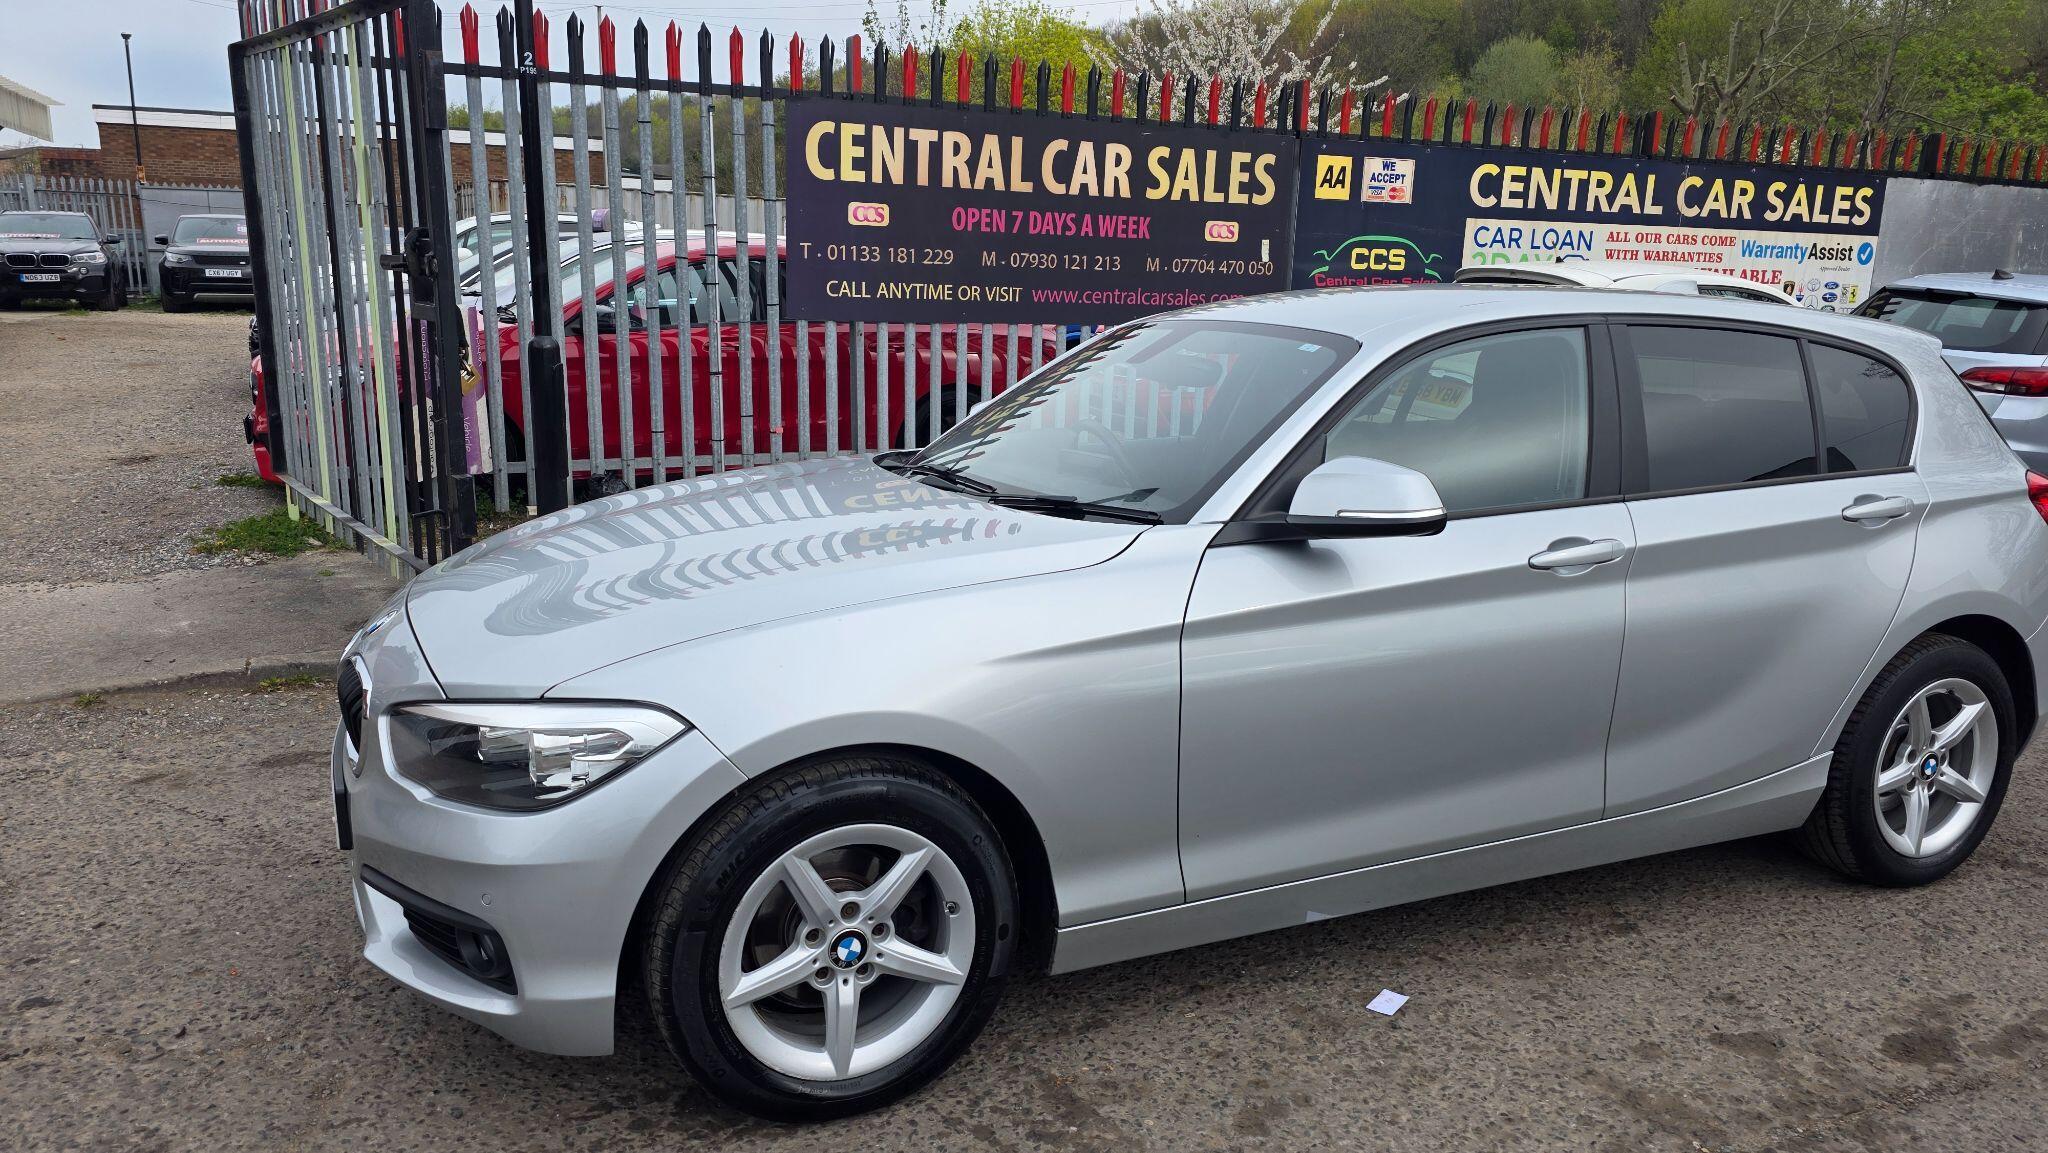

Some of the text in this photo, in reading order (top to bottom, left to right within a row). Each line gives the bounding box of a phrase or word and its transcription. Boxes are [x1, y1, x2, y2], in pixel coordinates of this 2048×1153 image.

[524, 51, 533, 65] 2
[805, 120, 1276, 205] CENTRAL CAR SALES
[1382, 160, 1396, 171] WE
[1319, 164, 1346, 188] AA
[1370, 172, 1406, 184] ACCEPT
[1469, 163, 1874, 226] CENTRAL CAR SALES
[952, 206, 1151, 240] OPEN 7 DAYS A WEEK
[1473, 225, 1594, 251] CAR LOAN
[1606, 231, 1737, 247] ALL OUR CARS COME
[827, 244, 880, 262] 01133
[888, 247, 915, 264] 181
[922, 248, 954, 265] 229
[1010, 252, 1057, 269] 07930
[1063, 254, 1087, 270] 121
[1094, 255, 1121, 271] 213
[1172, 258, 1215, 274] 07704
[1219, 260, 1245, 275] 470
[1248, 261, 1273, 276] 050
[1351, 247, 1406, 271] CCS
[1605, 248, 1723, 263] WITH WARRANTIES
[1314, 273, 1367, 287] Central
[826, 280, 1243, 306] CALL ANYTIME OR VISIT www.centralcarsalesco
